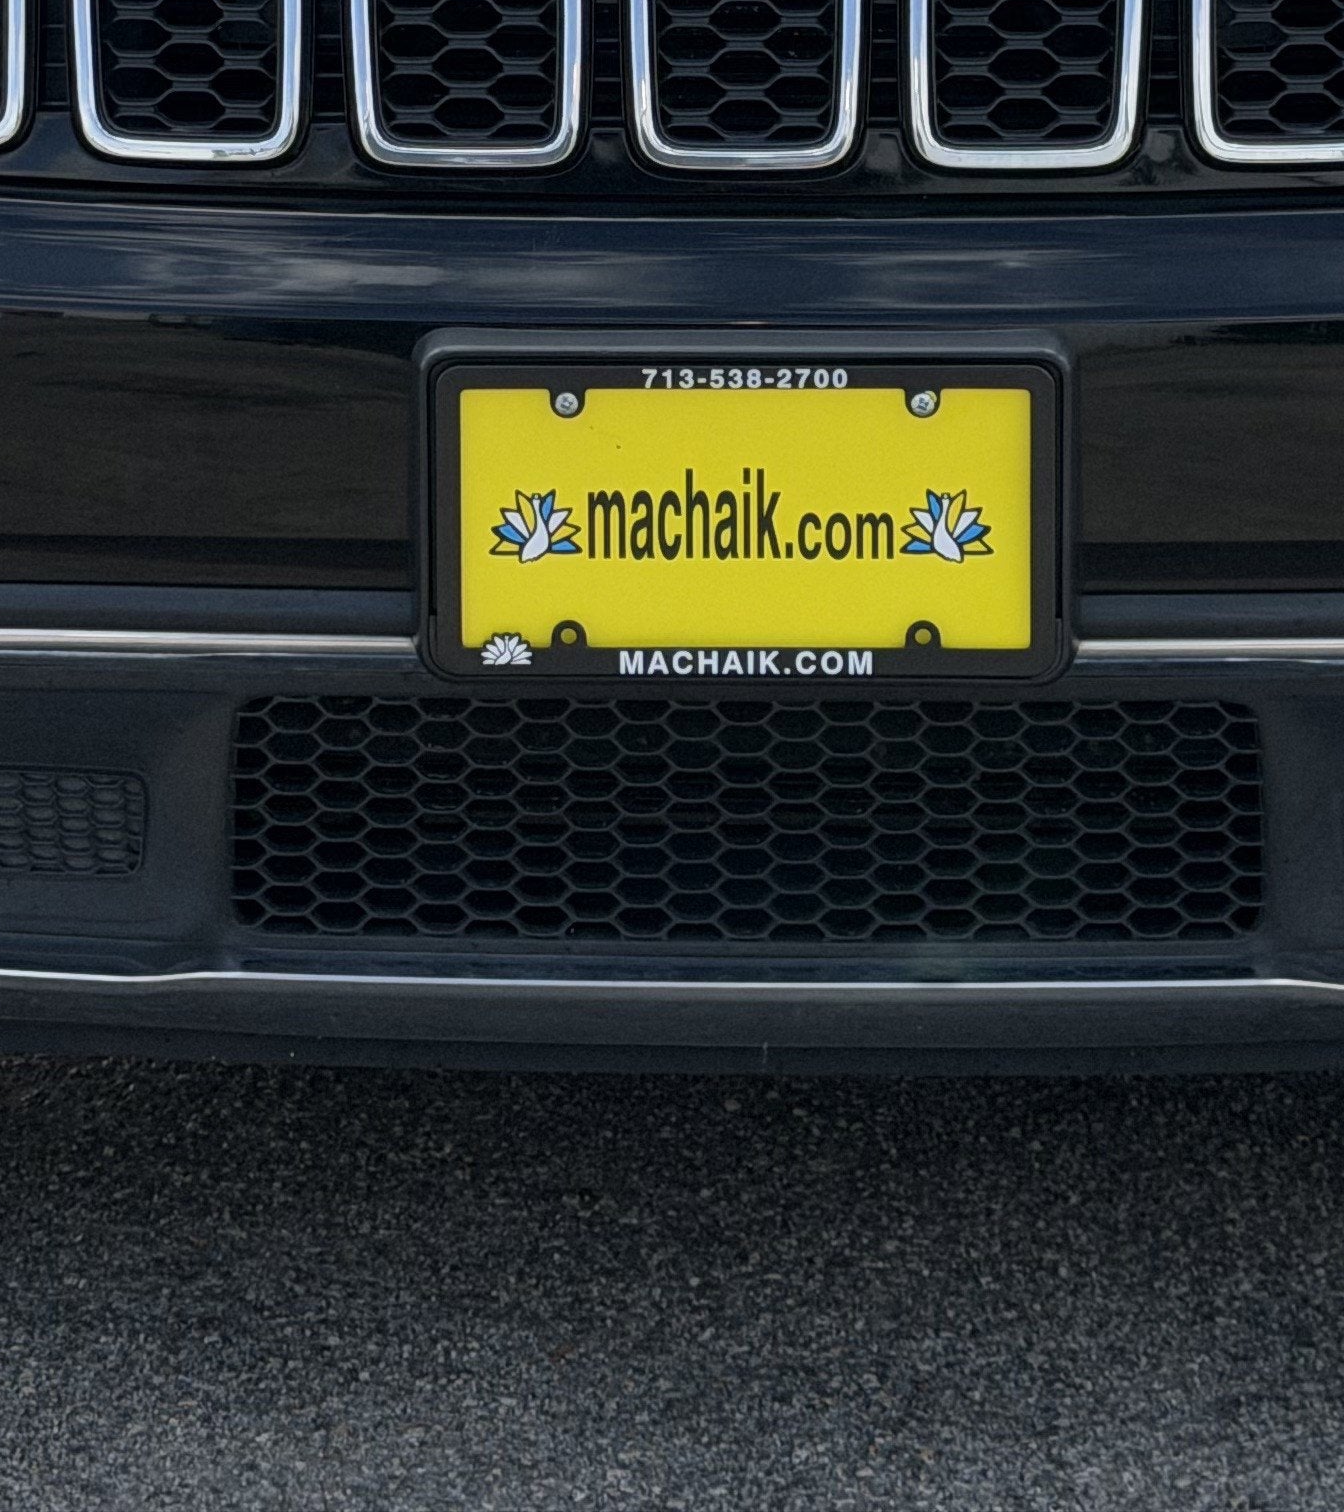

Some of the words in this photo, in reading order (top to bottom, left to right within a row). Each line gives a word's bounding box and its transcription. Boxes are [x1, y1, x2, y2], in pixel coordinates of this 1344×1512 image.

[641, 368, 849, 389] 713-538-2700
[587, 467, 895, 560] machaik.com
[618, 650, 874, 676] MACHAIK.COM
